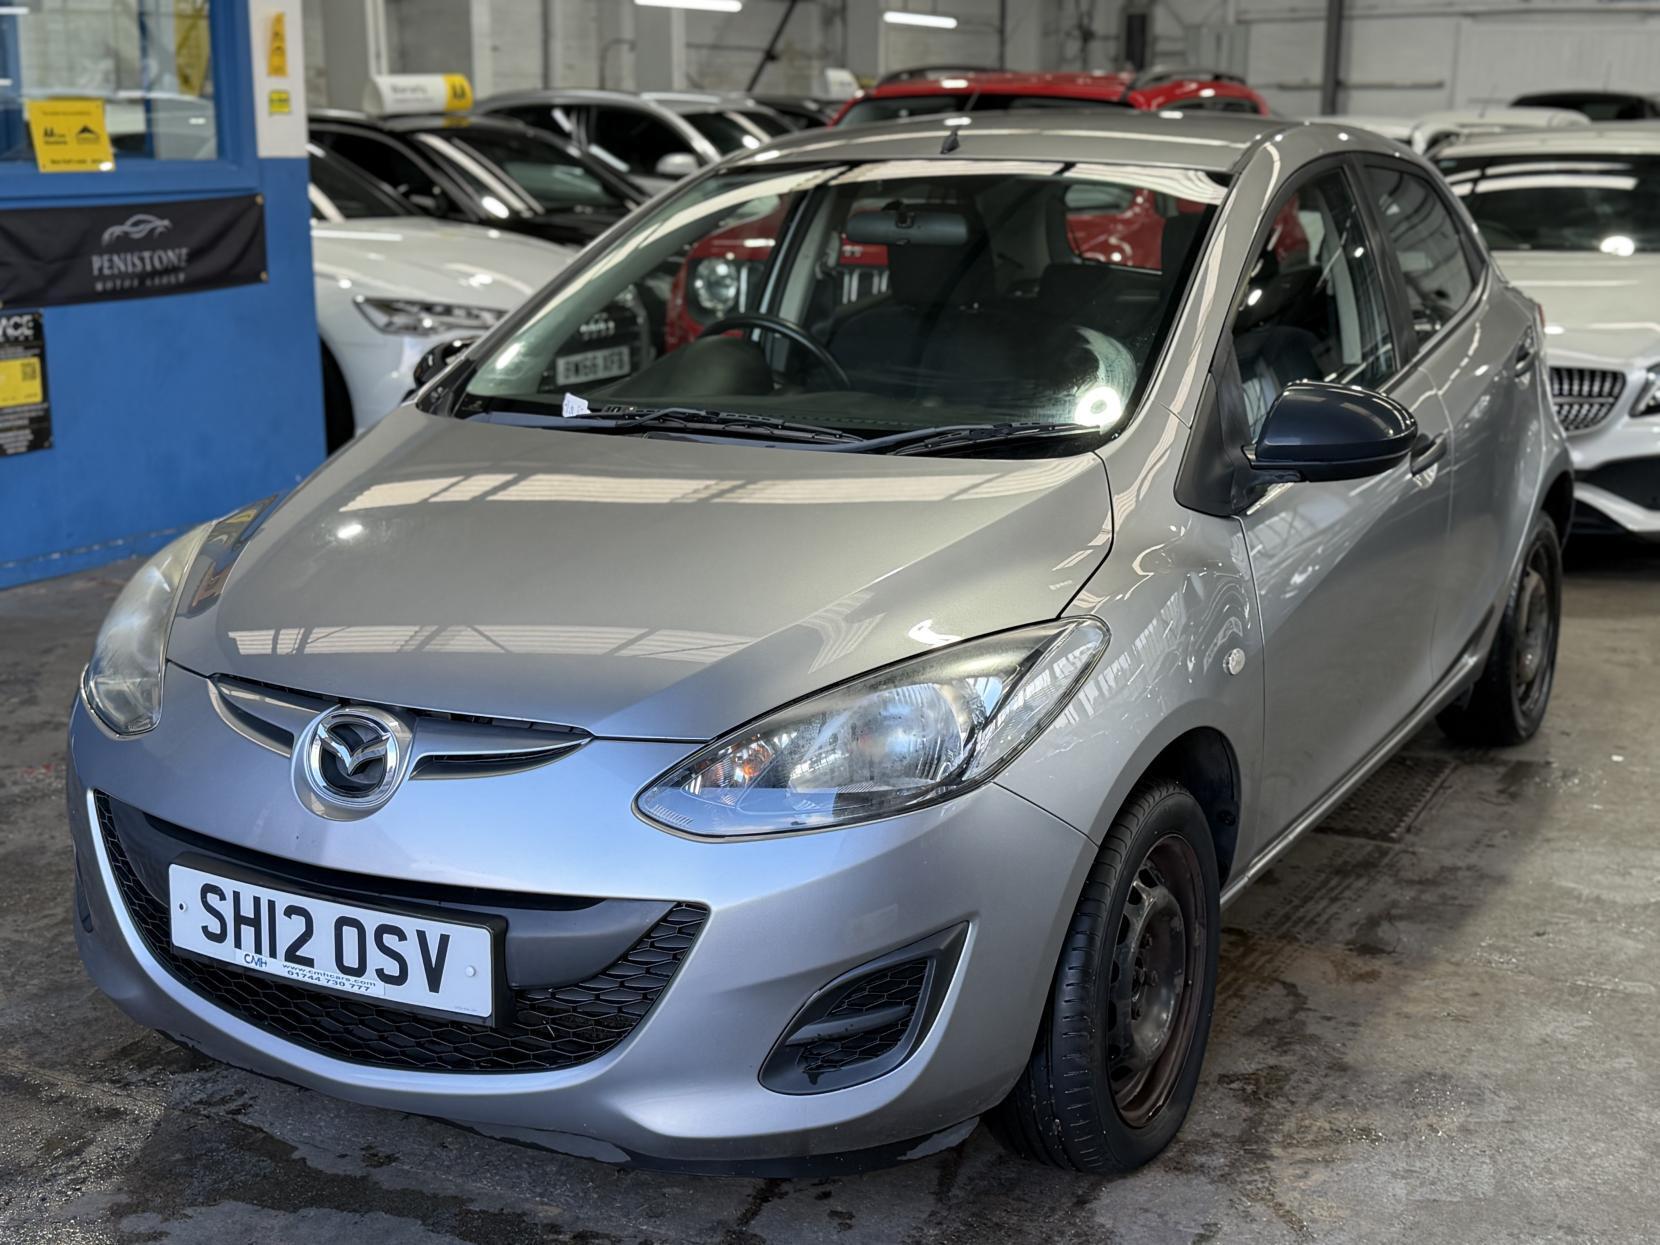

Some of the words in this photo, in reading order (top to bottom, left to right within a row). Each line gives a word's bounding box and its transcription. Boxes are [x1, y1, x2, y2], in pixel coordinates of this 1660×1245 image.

[91, 247, 189, 276] PENISTONE
[200, 883, 315, 969] SH12
[334, 915, 451, 994] OSV
[282, 963, 376, 987] www.cmhcars.com
[287, 969, 321, 982] 01744
[325, 977, 346, 987] 730
[349, 982, 370, 992] 777
